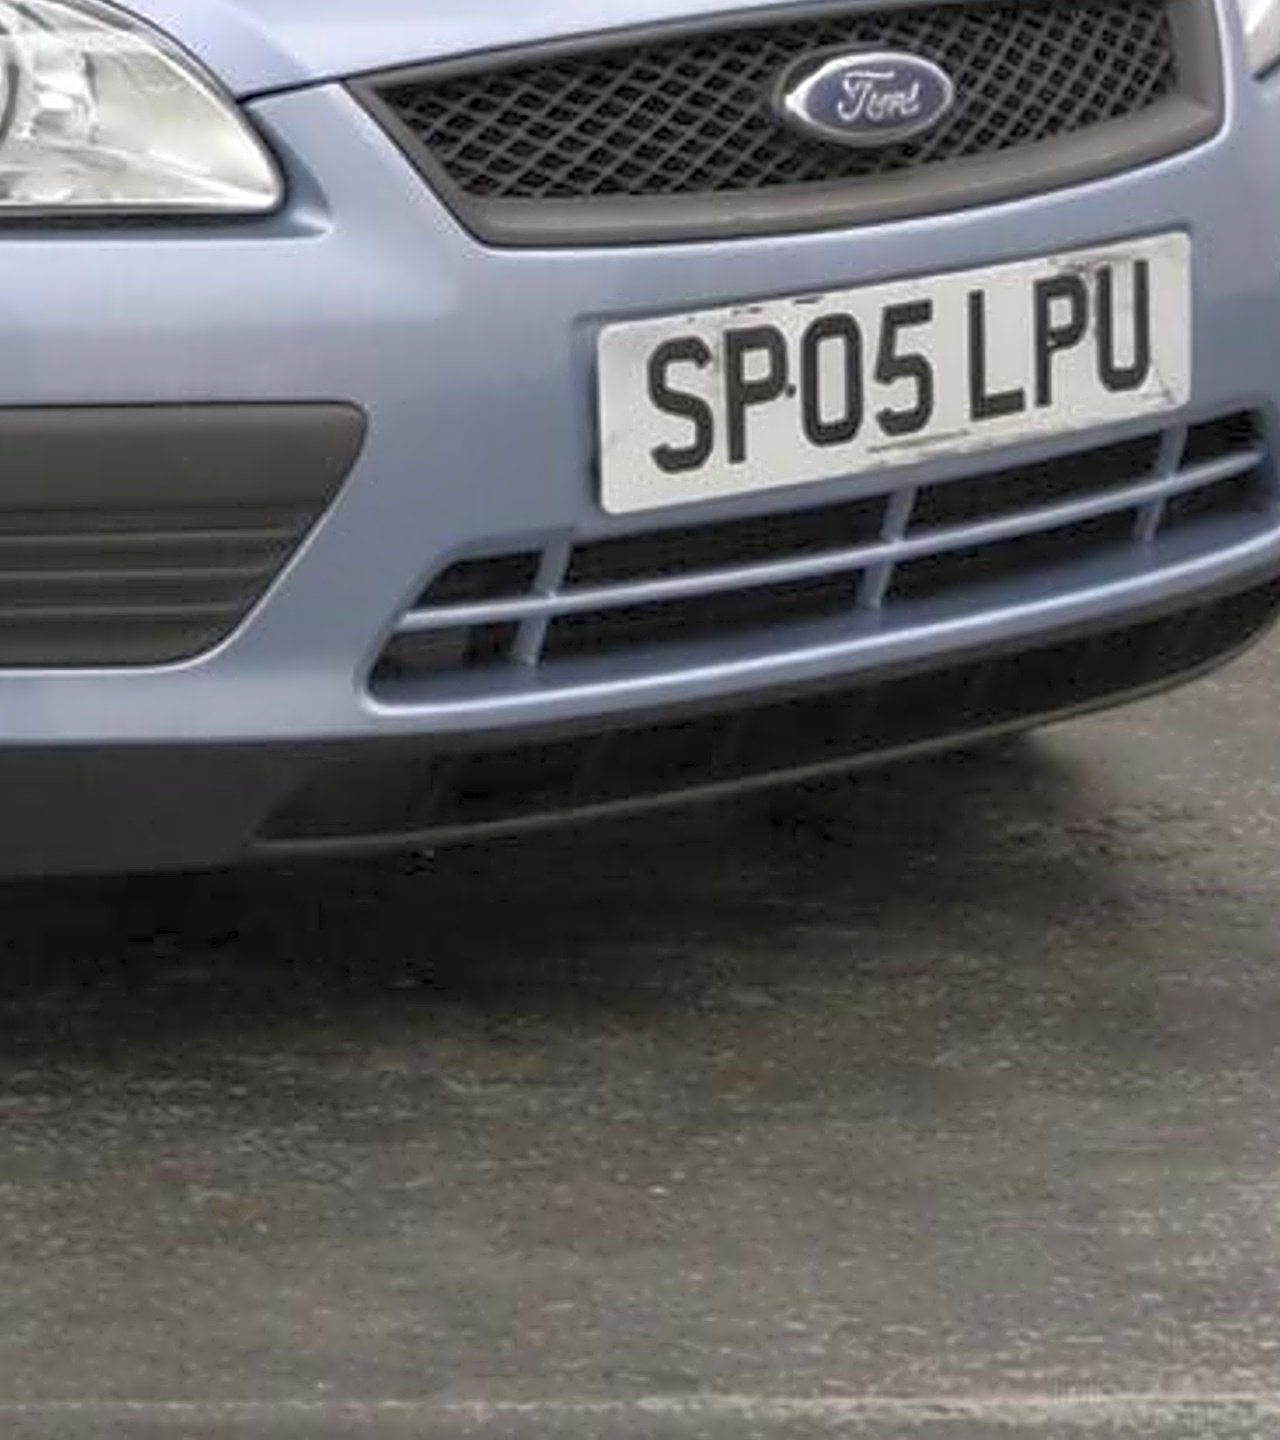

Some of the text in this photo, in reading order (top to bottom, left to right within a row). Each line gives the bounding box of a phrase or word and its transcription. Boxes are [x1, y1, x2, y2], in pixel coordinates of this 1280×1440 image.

[837, 70, 920, 121] Ford
[646, 259, 1150, 474] SP05 LPU
